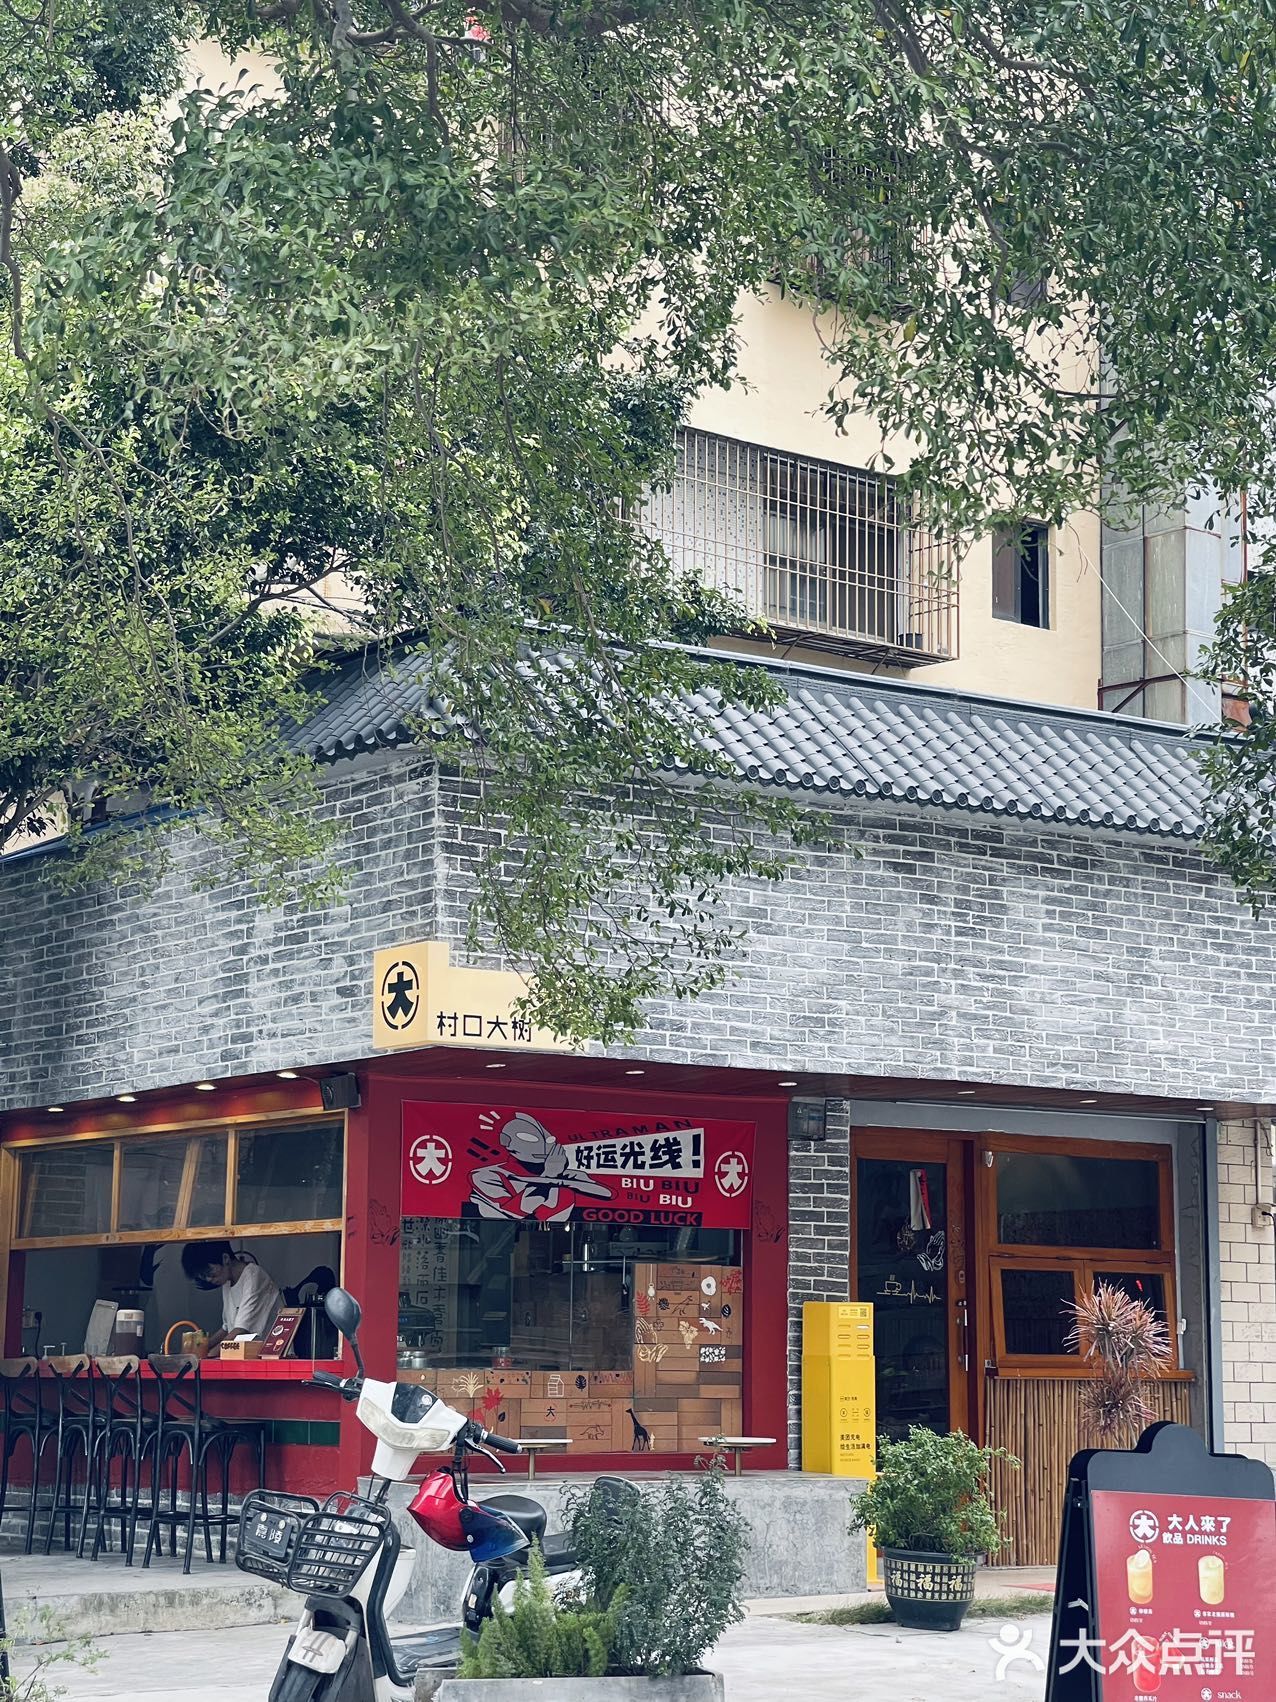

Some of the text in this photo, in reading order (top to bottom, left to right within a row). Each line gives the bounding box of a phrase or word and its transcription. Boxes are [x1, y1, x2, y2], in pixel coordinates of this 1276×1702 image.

[385, 970, 416, 1021] 大
[436, 1010, 532, 1043] 村口大树
[568, 1119, 693, 1142] ULTRAMAN
[413, 1140, 448, 1179] 大
[718, 1156, 745, 1192] 大
[621, 1177, 700, 1195] BIU BIU
[626, 1191, 693, 1208] BIU BIU
[582, 1209, 699, 1226] GOOD LUCK
[1132, 1513, 1156, 1540] 大
[1167, 1513, 1232, 1533] 大人來了
[1162, 1531, 1227, 1546] 飲品 DRINKS
[890, 1570, 963, 1592] 福 福 福
[1217, 1690, 1242, 1700] snack
